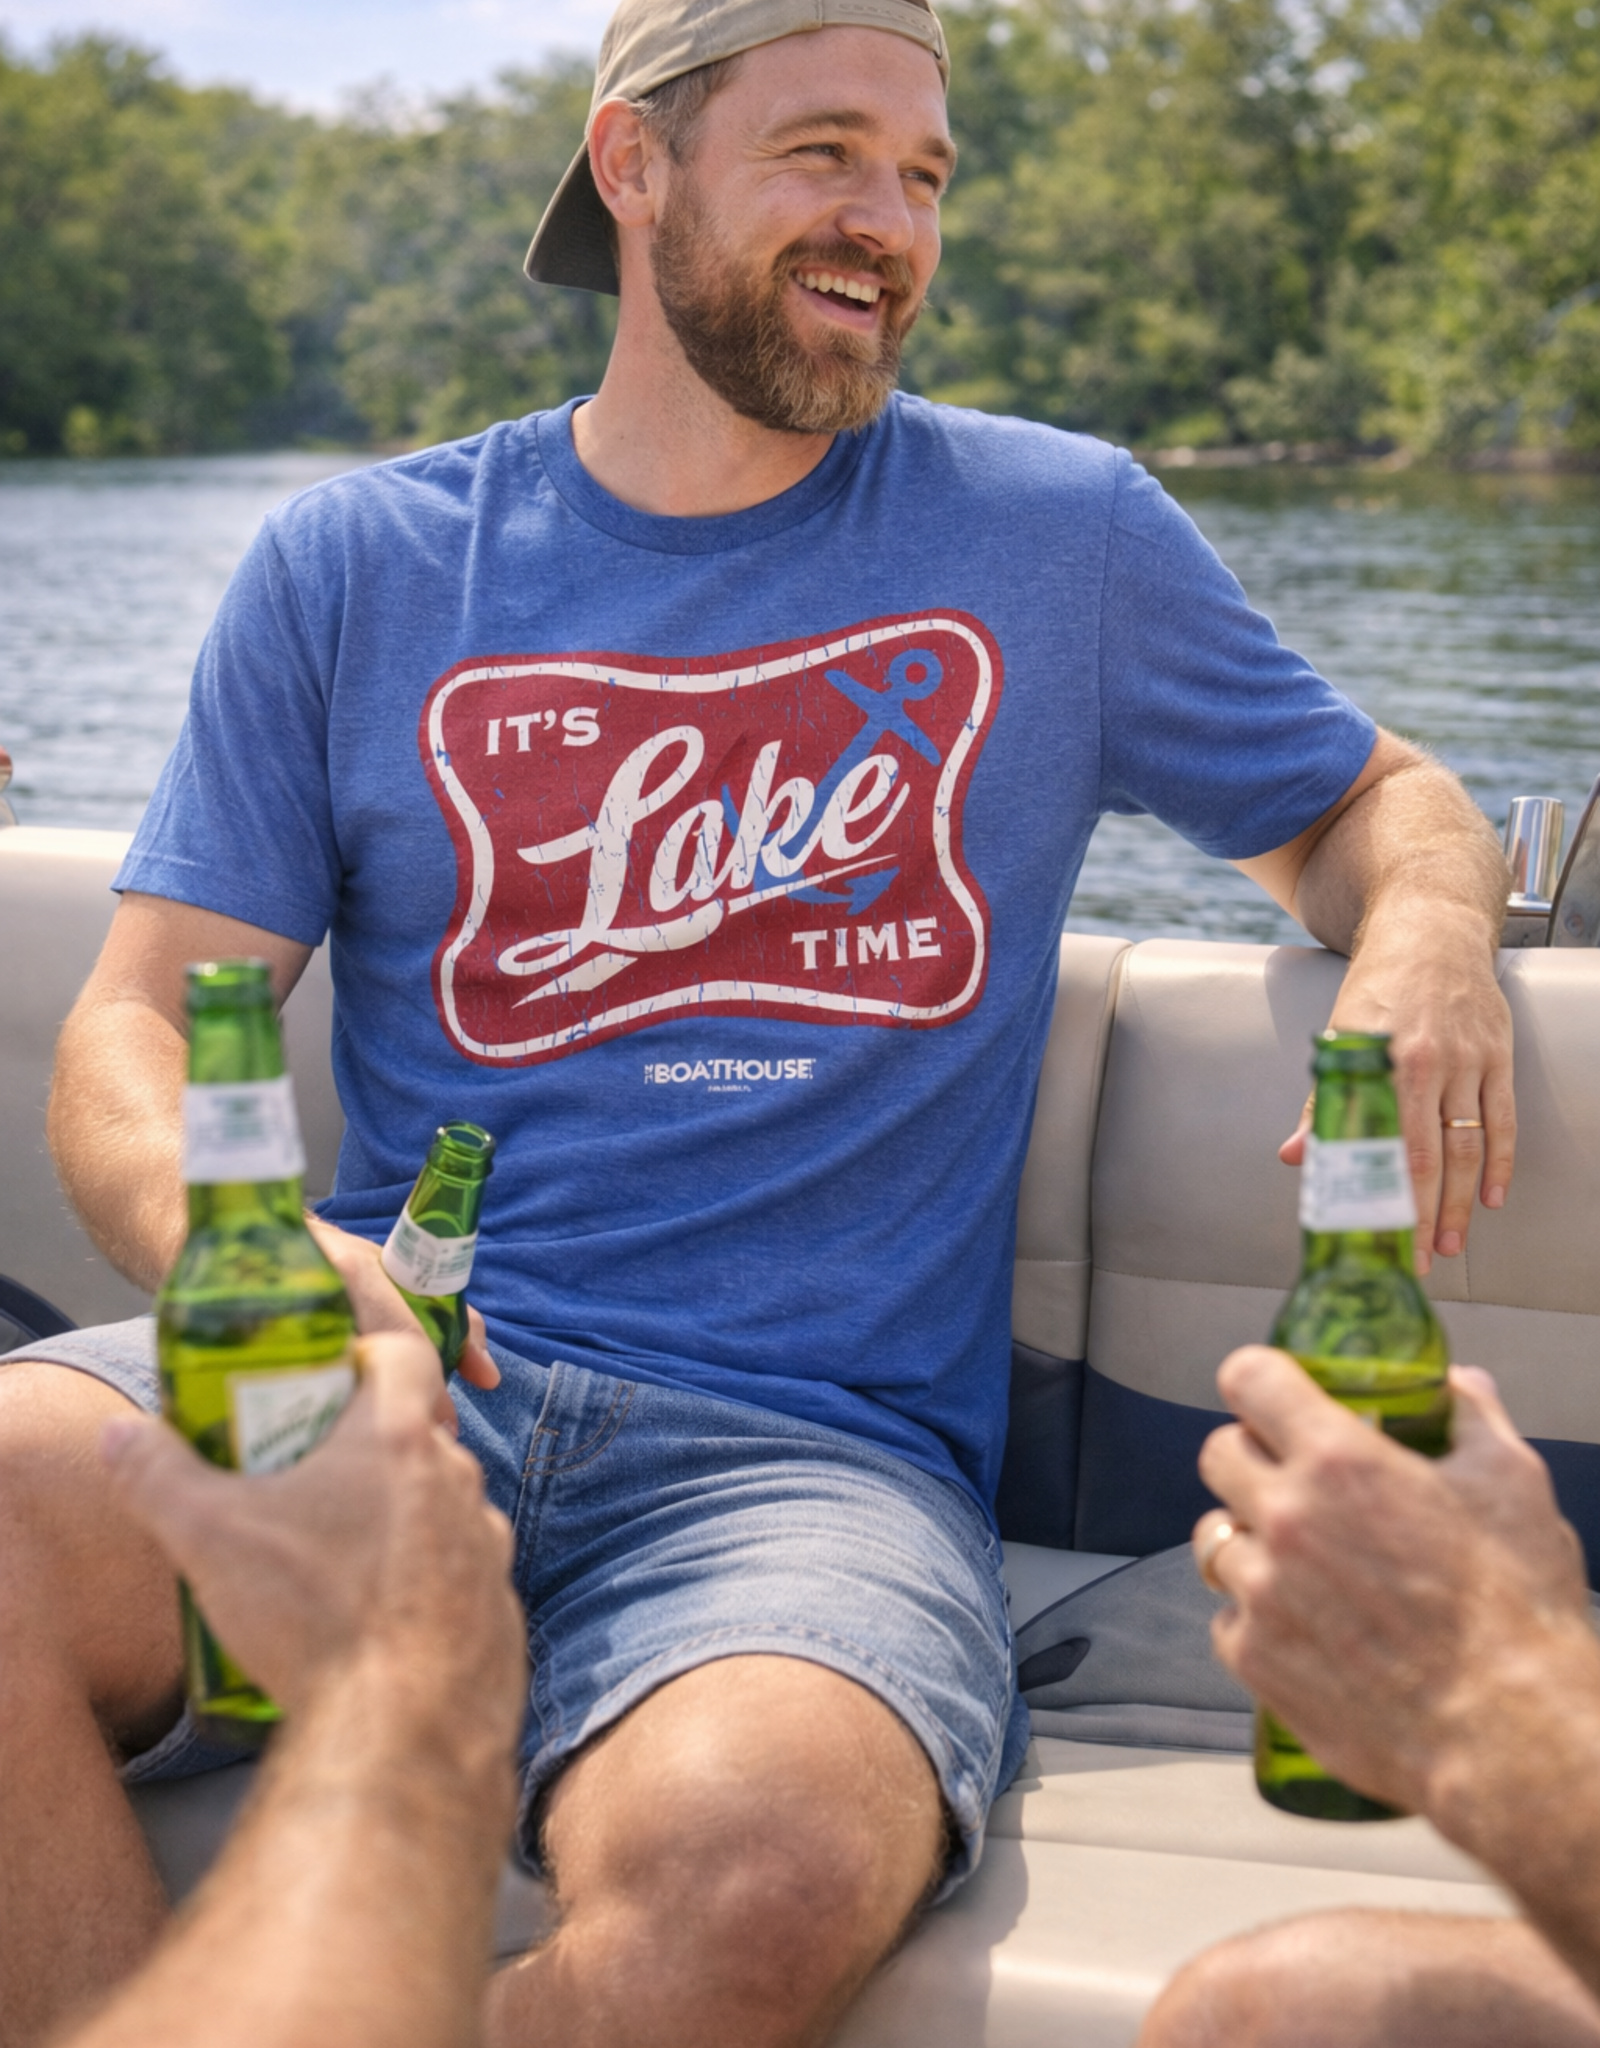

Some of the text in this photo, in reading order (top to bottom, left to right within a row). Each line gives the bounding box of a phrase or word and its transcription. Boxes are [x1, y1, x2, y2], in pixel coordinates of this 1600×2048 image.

[486, 707, 601, 756] IT'S
[498, 724, 911, 977] Lake
[791, 916, 942, 970] TIME
